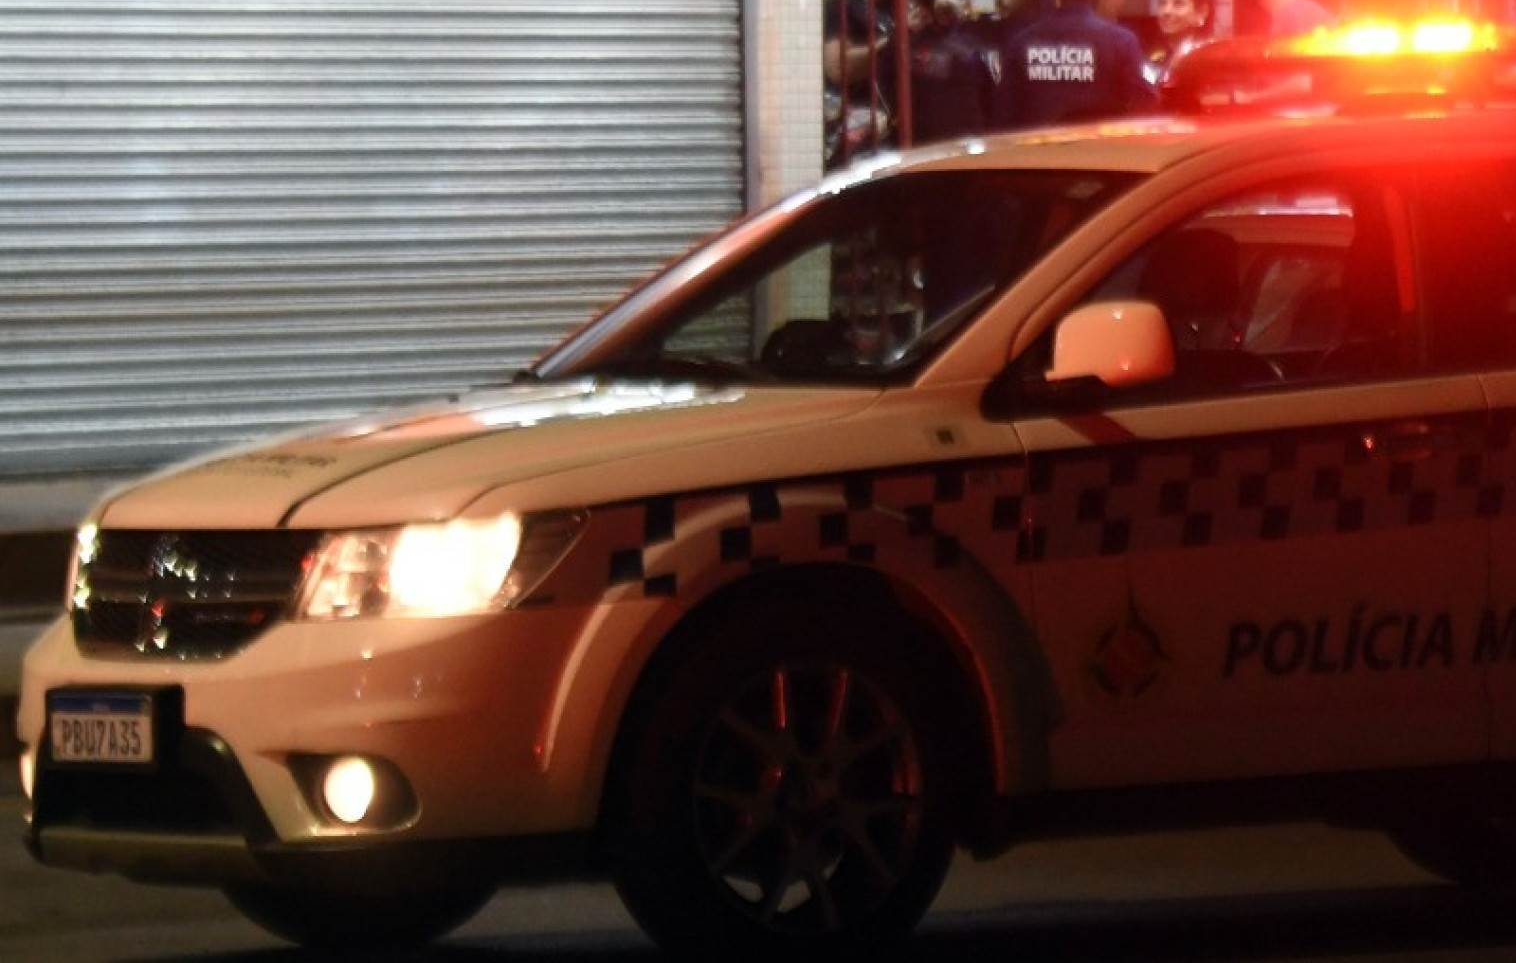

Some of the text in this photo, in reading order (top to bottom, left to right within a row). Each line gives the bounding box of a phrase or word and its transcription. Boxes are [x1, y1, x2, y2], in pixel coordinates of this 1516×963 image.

[1027, 45, 1094, 64] POLÍCIA
[1028, 65, 1095, 82] MILITAR
[1220, 598, 1457, 680] POLÍCIA
